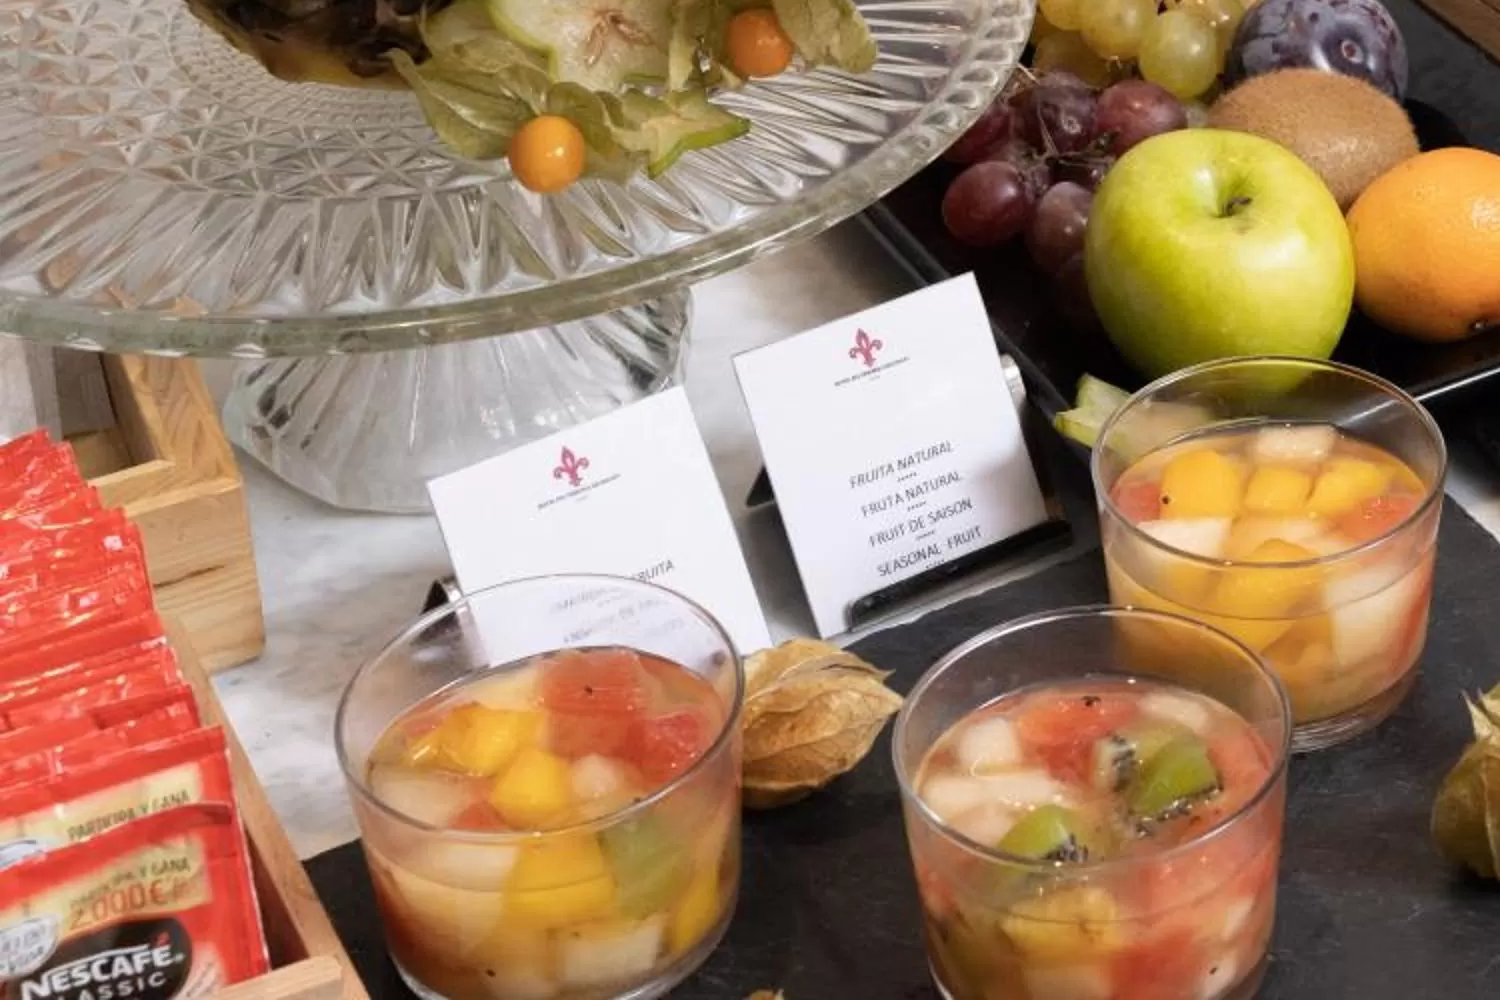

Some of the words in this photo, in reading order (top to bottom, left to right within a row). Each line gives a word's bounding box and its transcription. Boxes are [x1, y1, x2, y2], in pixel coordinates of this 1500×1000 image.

[849, 463, 895, 488] FRUITA
[897, 440, 955, 470] NATURAL
[861, 493, 904, 517] FRUTA
[905, 470, 962, 500] NATURAL
[868, 523, 905, 548] FRUIT
[909, 516, 926, 533] DE
[927, 496, 973, 523] SAISON
[877, 543, 942, 577] SEASONAL
[947, 525, 982, 549] FRUIT
[57, 970, 167, 1000] ASSIC
